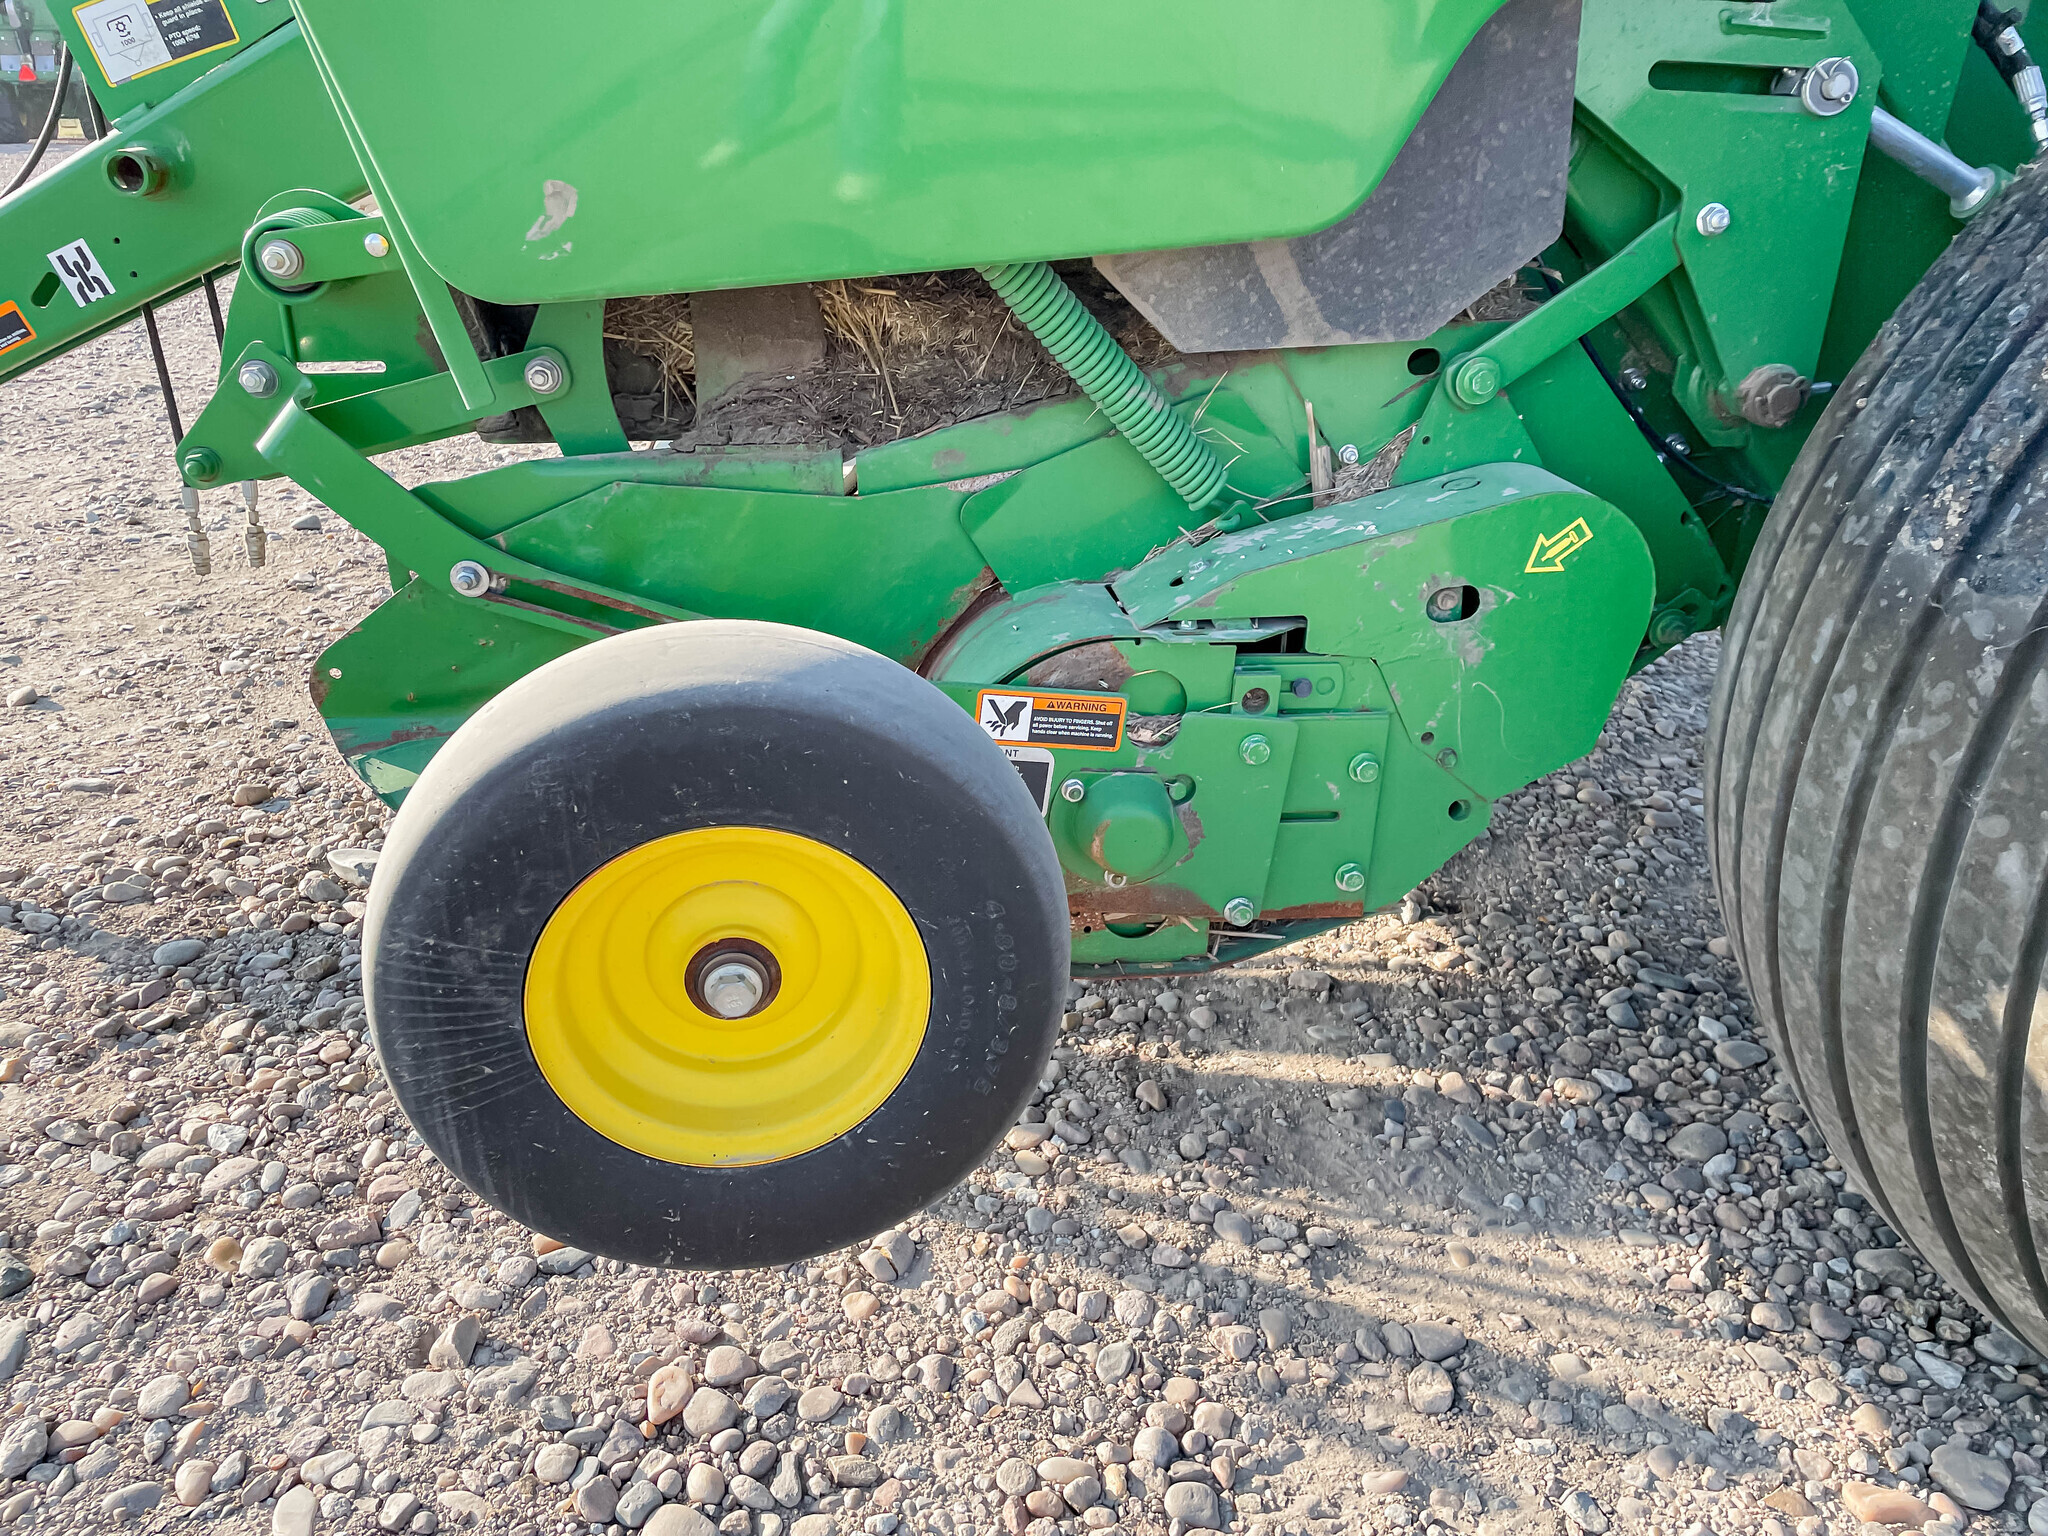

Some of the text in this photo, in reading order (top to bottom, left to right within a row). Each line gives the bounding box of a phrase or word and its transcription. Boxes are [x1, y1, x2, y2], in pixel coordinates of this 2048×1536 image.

[158, 10, 173, 18] Keep
[174, 5, 182, 13] all
[162, 15, 179, 27] guard
[168, 25, 201, 40] PTO speed:
[121, 37, 136, 46] 1000
[172, 33, 200, 47] 1000 RPM
[1056, 701, 1108, 712] WARNING
